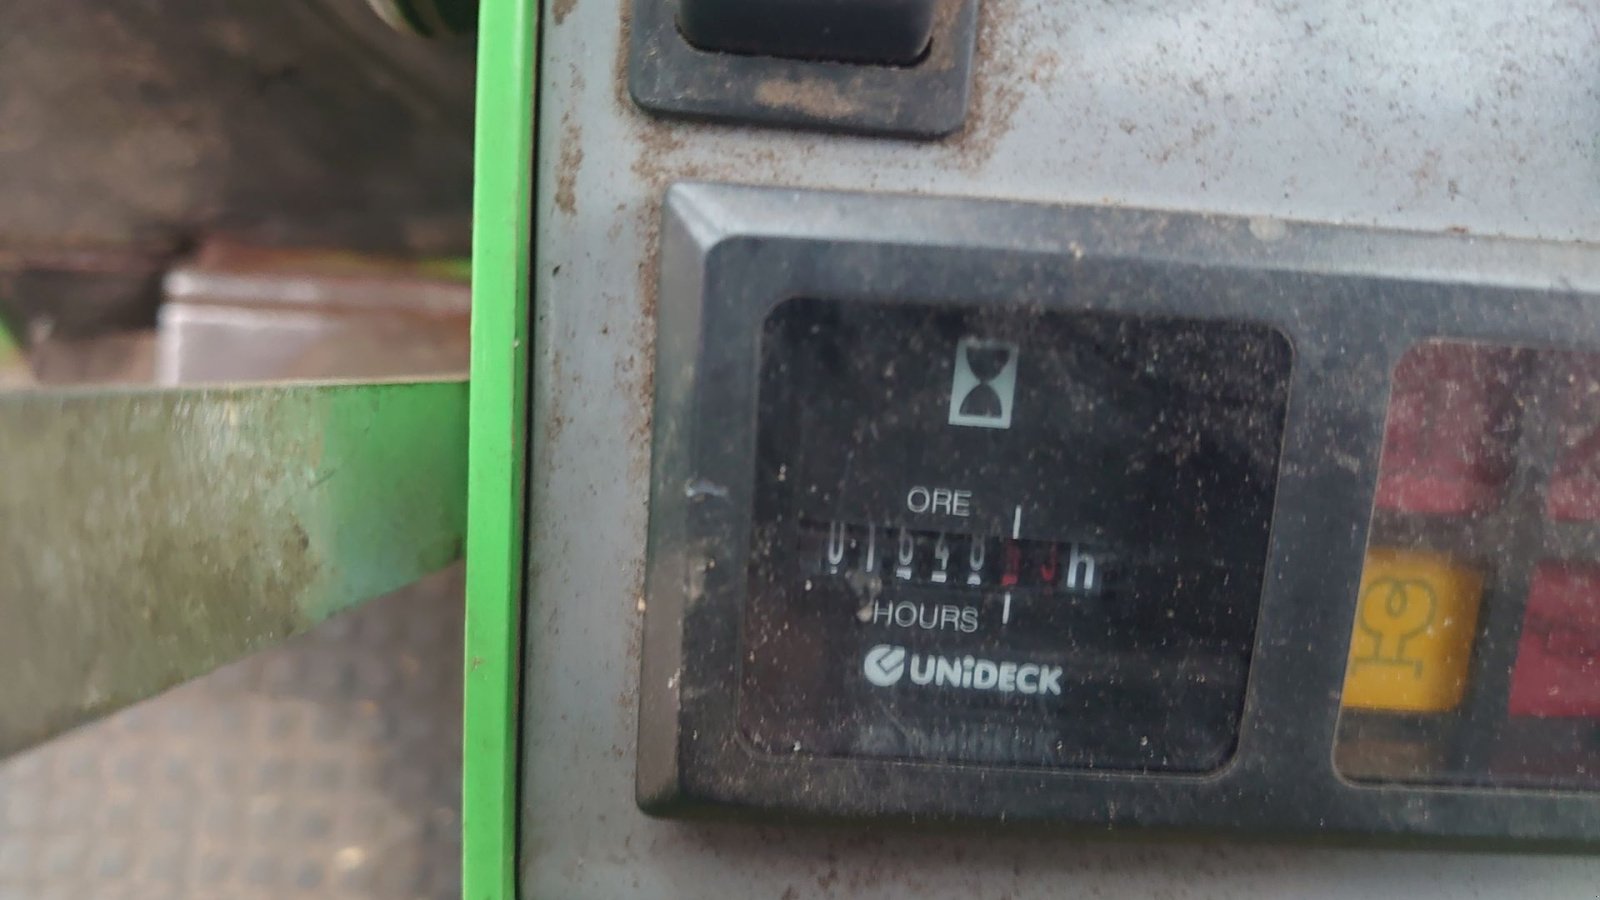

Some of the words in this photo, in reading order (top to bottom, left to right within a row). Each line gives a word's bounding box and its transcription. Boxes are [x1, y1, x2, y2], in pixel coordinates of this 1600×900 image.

[907, 486, 972, 517] ORE
[1066, 542, 1096, 589] h
[872, 600, 979, 633] HOURS
